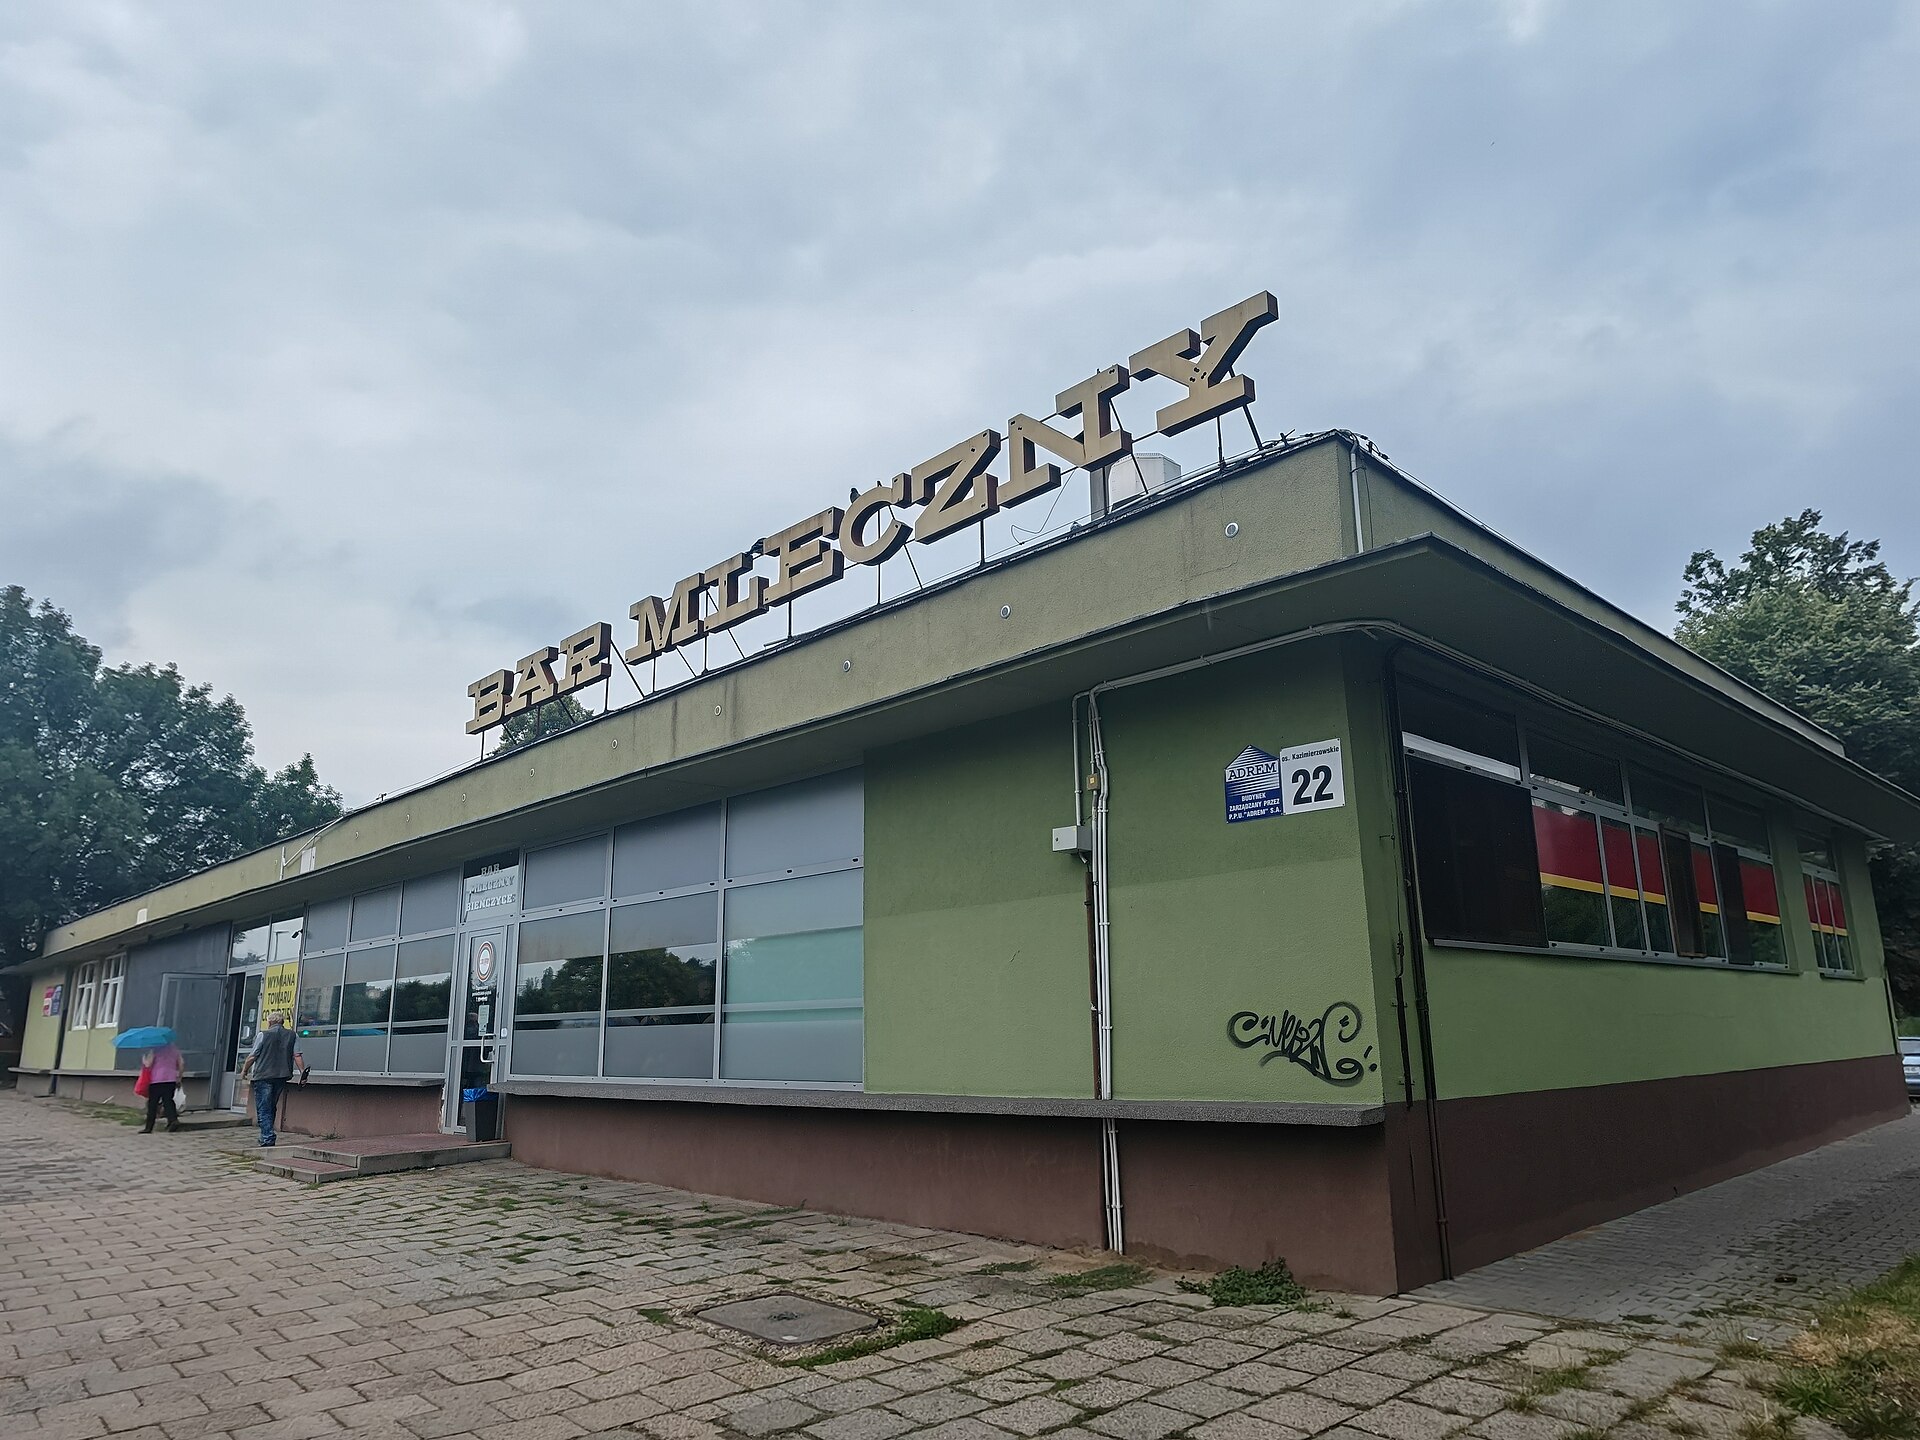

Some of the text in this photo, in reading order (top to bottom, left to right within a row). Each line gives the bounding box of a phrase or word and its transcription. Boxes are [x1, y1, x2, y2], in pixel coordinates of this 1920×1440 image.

[465, 290, 1279, 734] BAR MLECZNY
[1292, 746, 1340, 760] Kazimierzowskie
[1227, 762, 1277, 780] ADREM
[1291, 765, 1334, 806] 22
[1241, 793, 1267, 802] BUDYNEK
[1229, 798, 1280, 812] ZARZĄDZANY PRZEZ
[1270, 806, 1282, 814] S.A.
[481, 863, 500, 877] BAR
[267, 974, 295, 988] WYMIANA
[268, 991, 292, 1005] TOWARU
